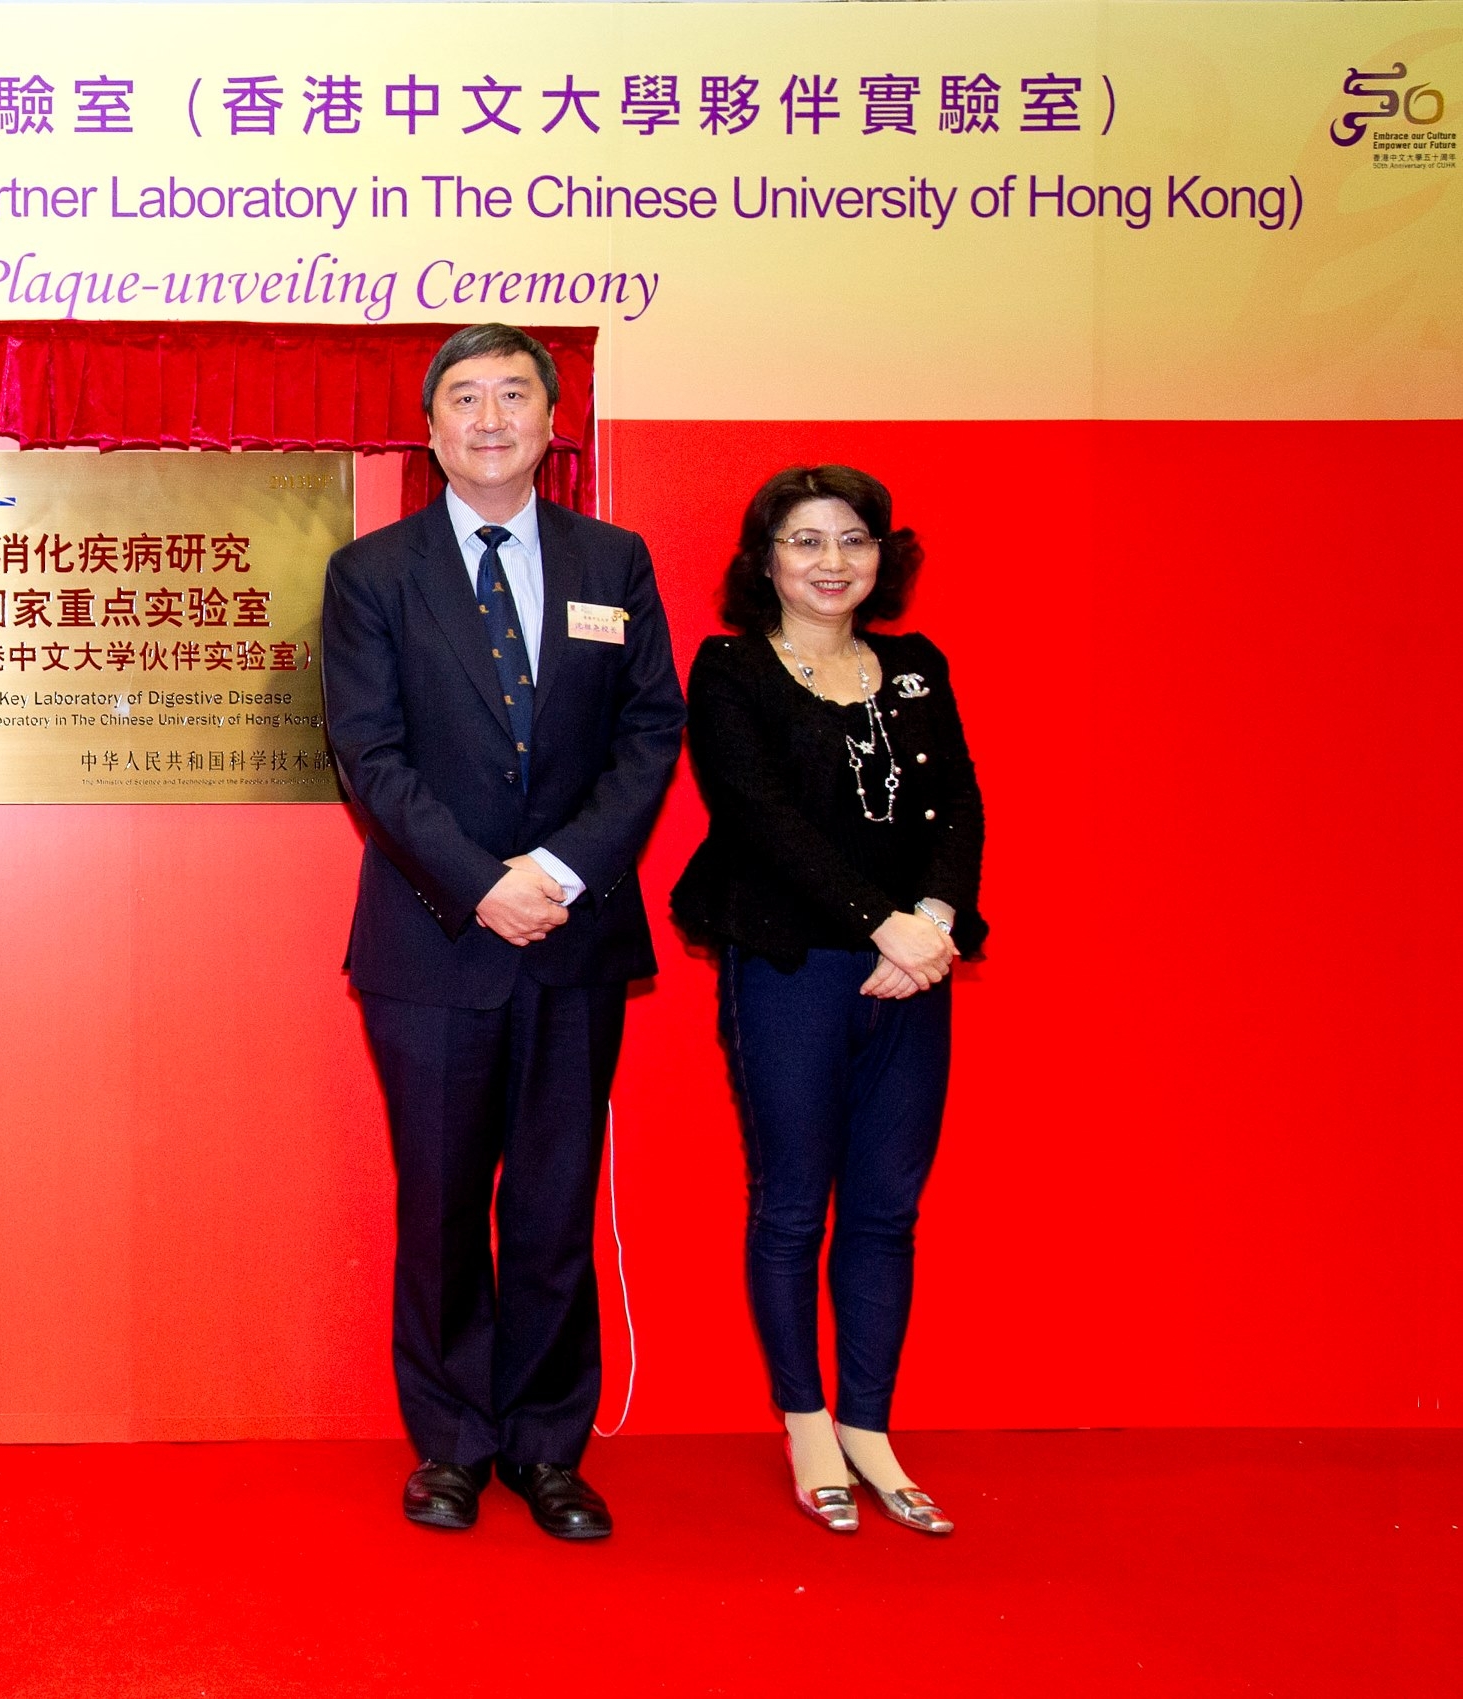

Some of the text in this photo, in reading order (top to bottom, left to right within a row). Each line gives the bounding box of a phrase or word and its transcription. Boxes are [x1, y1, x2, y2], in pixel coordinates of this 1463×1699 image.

[1373, 132, 1409, 140] Embrace
[1427, 132, 1456, 140] Culture
[1373, 141, 1411, 150] Empower
[1430, 141, 1456, 149] Future
[112, 176, 357, 229] Laboratory
[373, 176, 407, 217] in
[422, 176, 512, 218] The
[528, 175, 717, 218] Chinese
[734, 176, 958, 230] University
[971, 175, 1017, 218] of
[1030, 175, 1151, 229] Hong
[1168, 175, 1305, 230] Kong)
[415, 258, 660, 321] Ceremony
[0, 692, 28, 708] Key
[35, 691, 122, 708] Laboratory
[127, 691, 143, 705] of
[149, 691, 223, 708] Digestive
[229, 691, 292, 705] Disease
[55, 714, 67, 726] in
[71, 714, 96, 726] The
[100, 714, 154, 726] Chinese
[158, 713, 224, 728] University
[228, 713, 241, 725] of
[246, 714, 281, 728] Hong
[285, 713, 324, 728] Kong)
[80, 750, 332, 772] 中华人民共和国科学技术部
